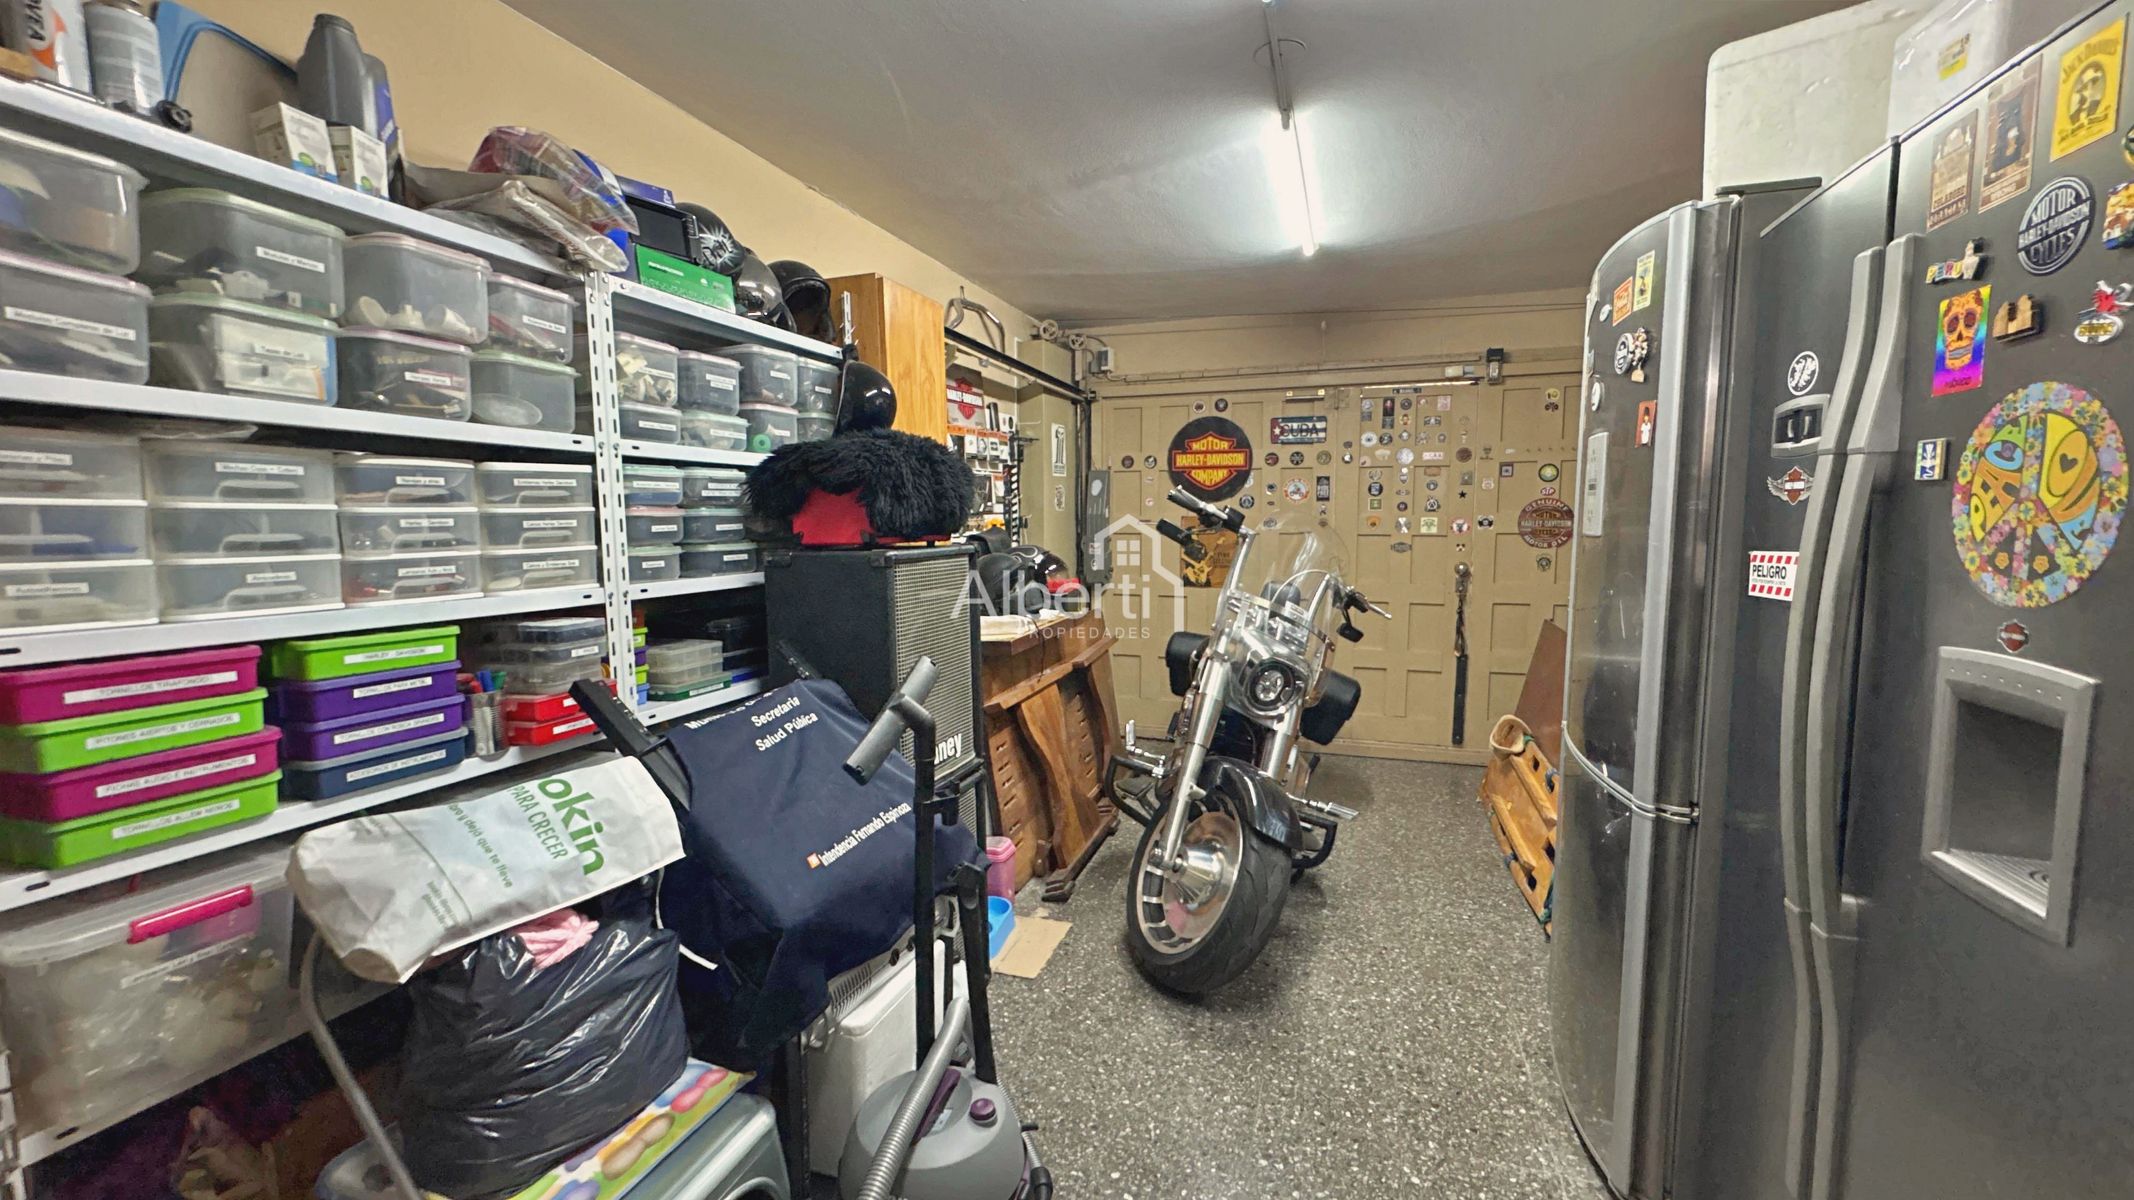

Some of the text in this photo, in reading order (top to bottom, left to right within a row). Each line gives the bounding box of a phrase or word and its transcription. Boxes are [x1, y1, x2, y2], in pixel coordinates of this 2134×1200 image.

[2031, 188, 2076, 226] MOTOR
[2031, 227, 2075, 263] CYCLES
[1925, 261, 1963, 284] PERU
[1193, 436, 1228, 450] MOTOR
[1176, 453, 1245, 467] HARLEY-DAVIDSON
[1192, 469, 1227, 486] COMPANY
[1752, 564, 1787, 579] PELIGRO
[751, 696, 801, 728] Secretaria
[756, 726, 788, 752] Salud
[509, 785, 569, 860] PARA CRECER
[852, 811, 885, 845] Fernando
[477, 835, 494, 856] que
[490, 850, 501, 867] te
[496, 863, 513, 889] lleve
